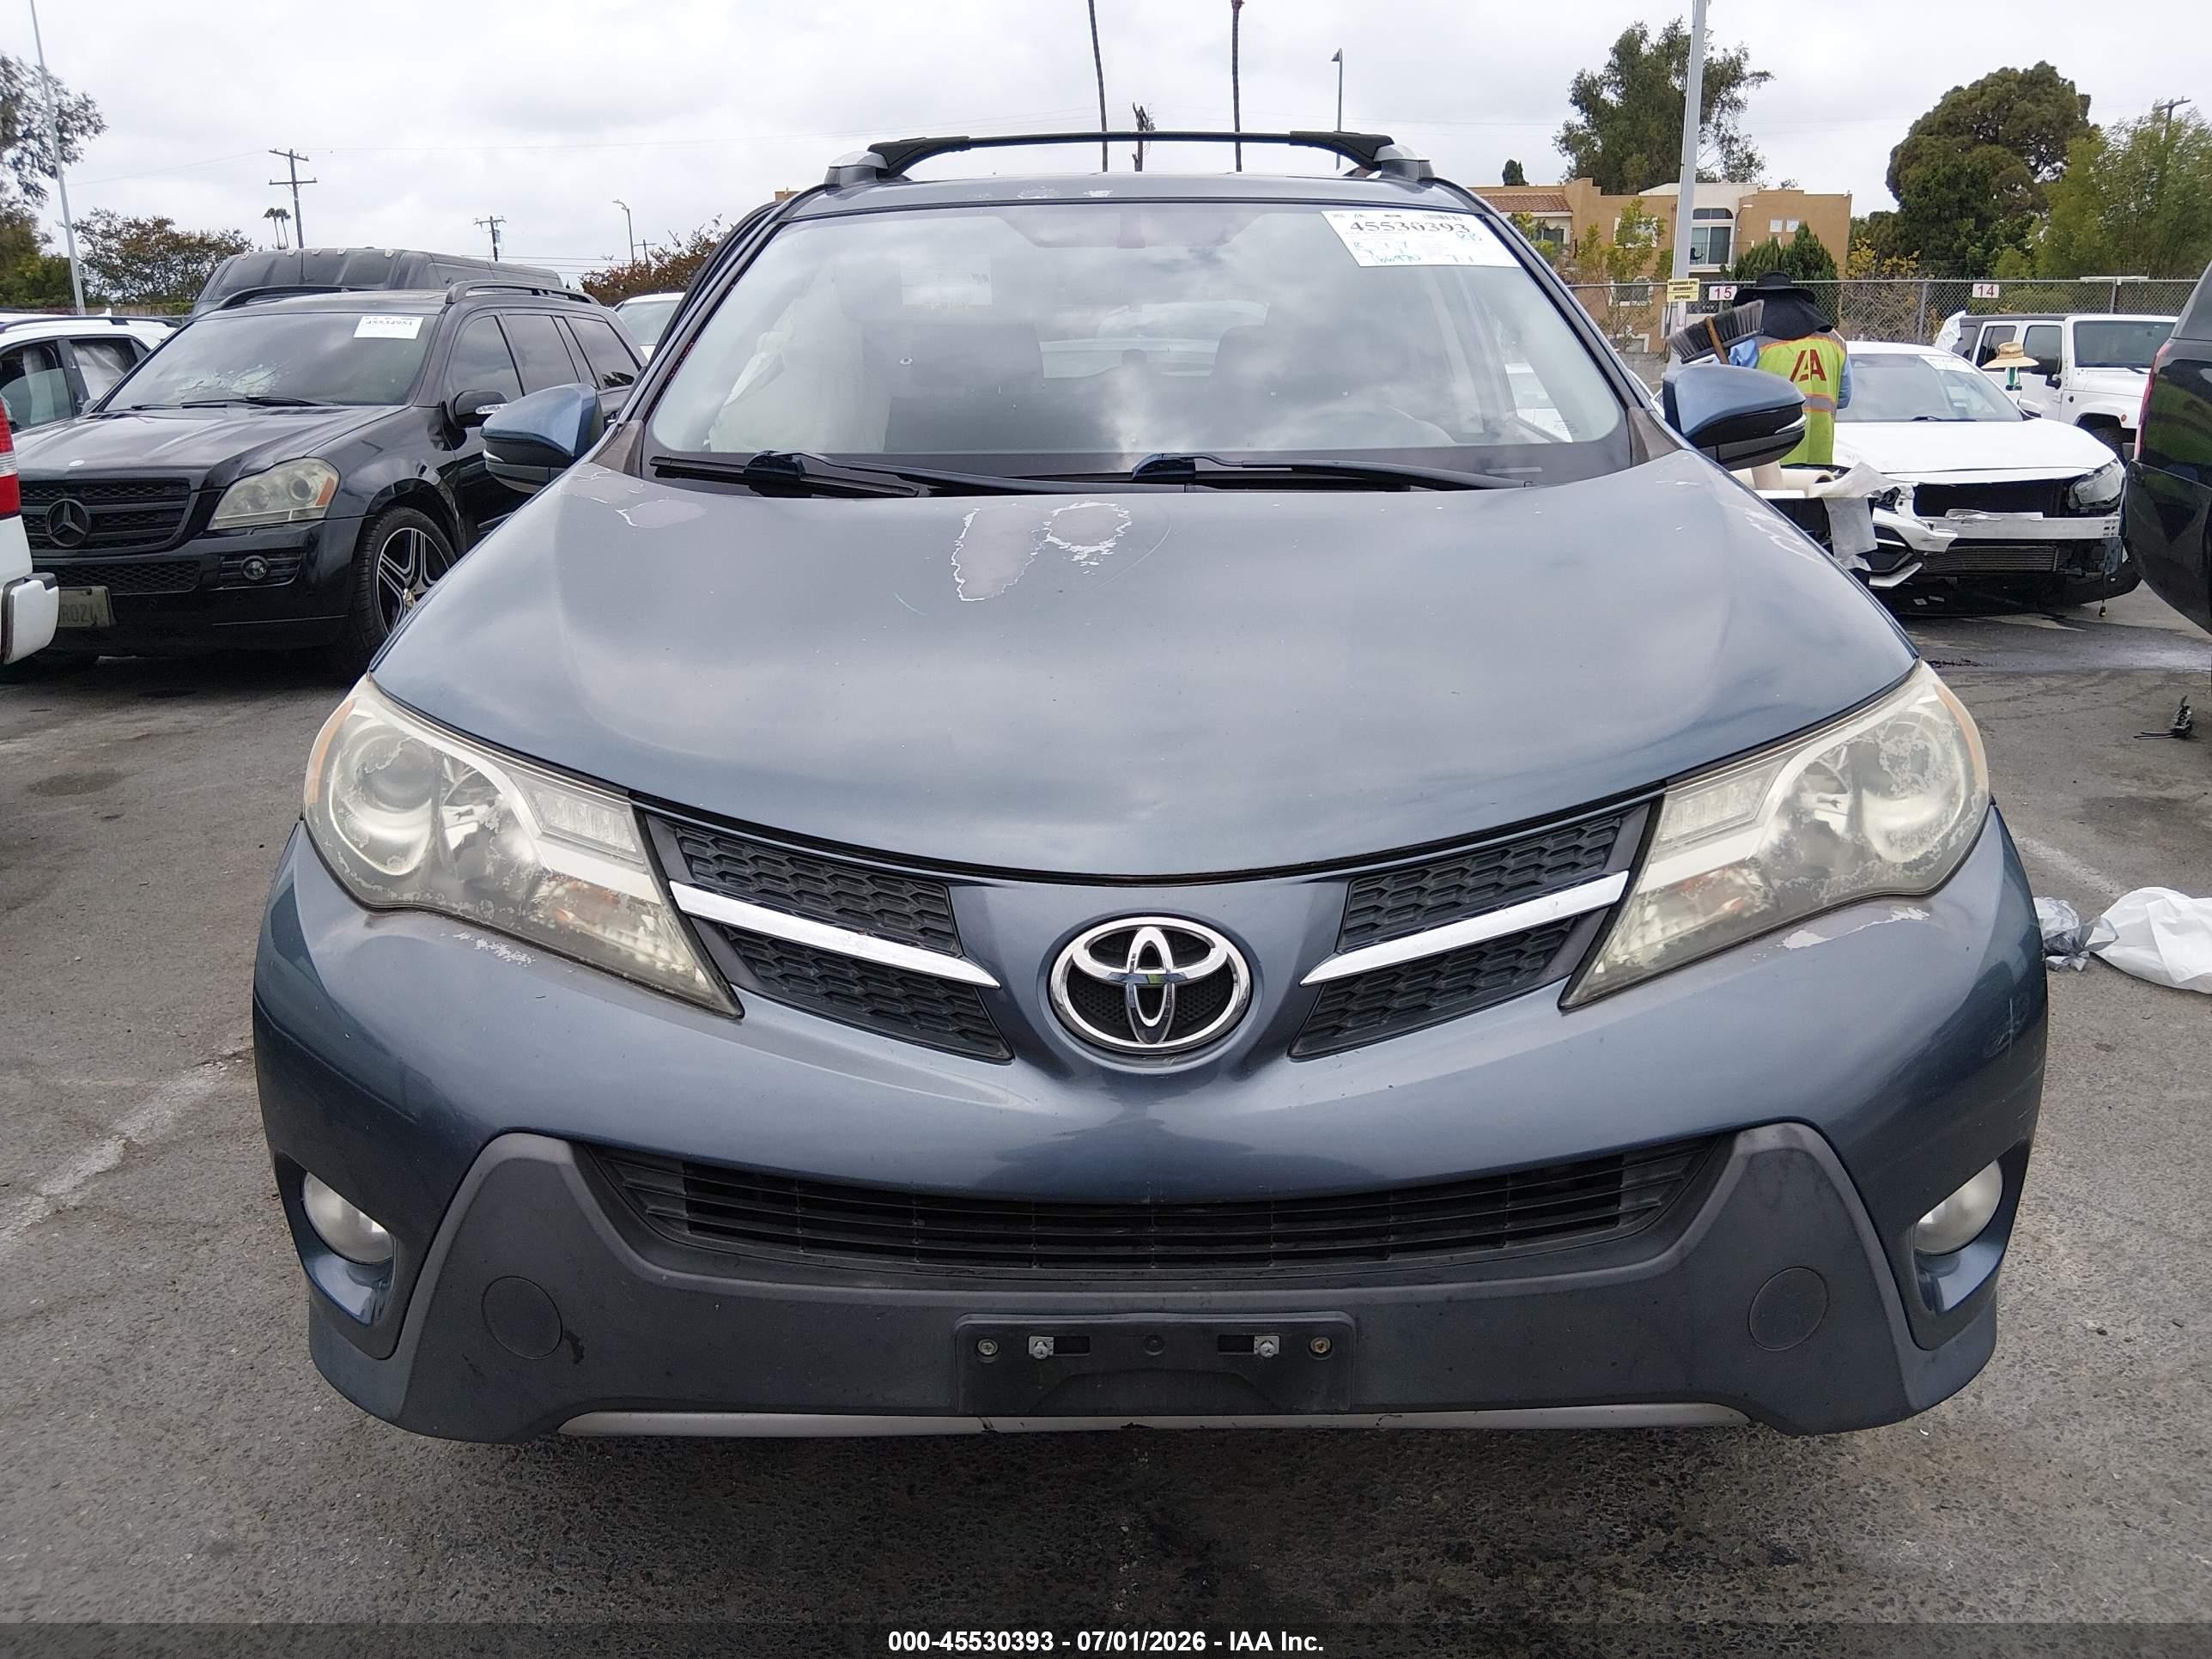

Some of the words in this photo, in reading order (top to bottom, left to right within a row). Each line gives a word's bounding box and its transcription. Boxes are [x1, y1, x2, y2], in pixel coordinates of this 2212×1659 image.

[1350, 222, 1470, 233] 45530393
[1714, 287, 1733, 299] 15
[1978, 285, 1995, 297] 14
